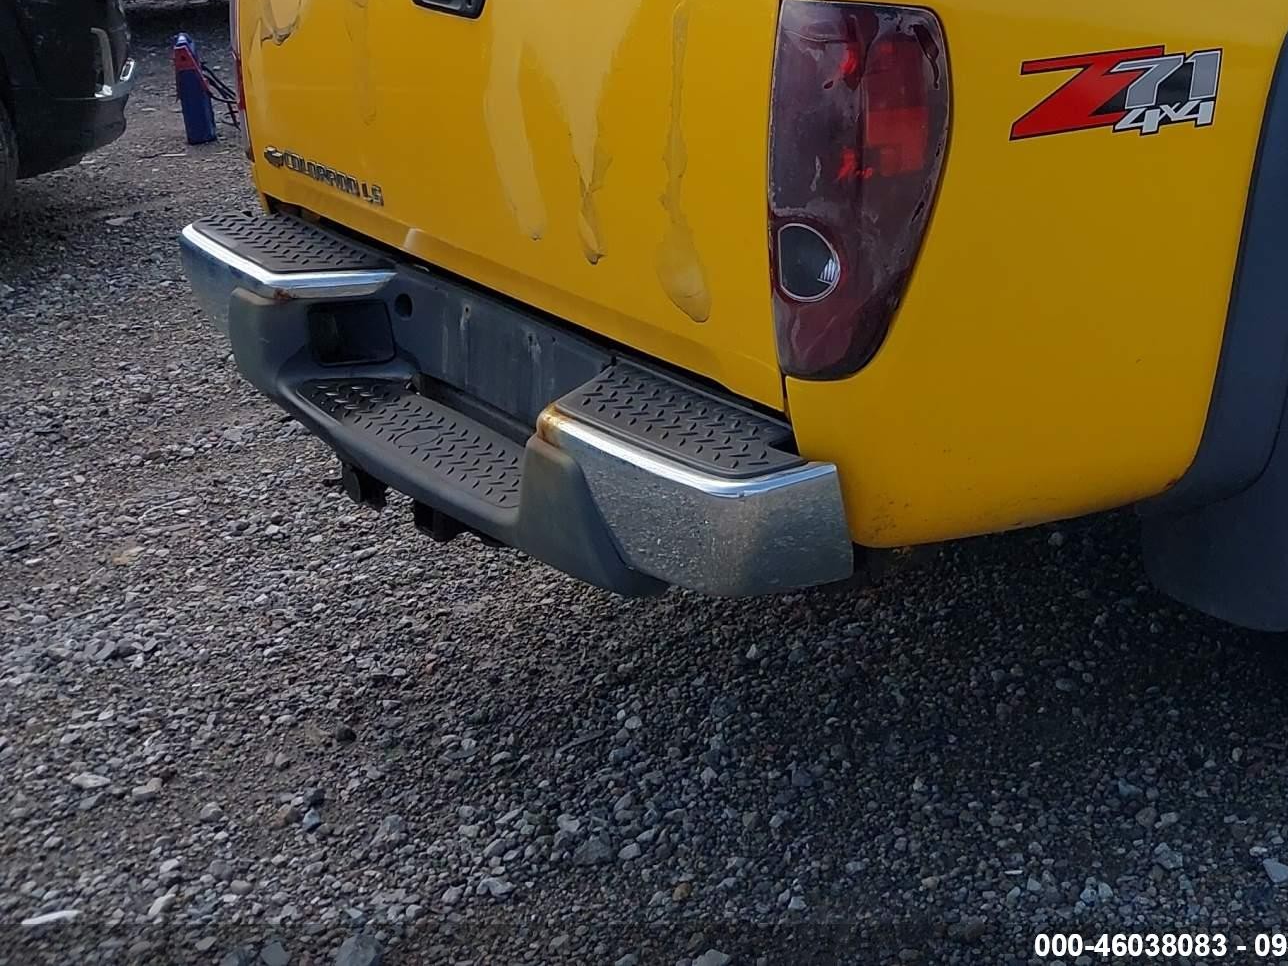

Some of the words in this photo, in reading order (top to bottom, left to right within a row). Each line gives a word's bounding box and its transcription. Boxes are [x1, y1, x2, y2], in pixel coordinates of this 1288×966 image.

[1009, 44, 1223, 141] Z71
[283, 150, 360, 197] COLORADO
[360, 180, 384, 206] LS
